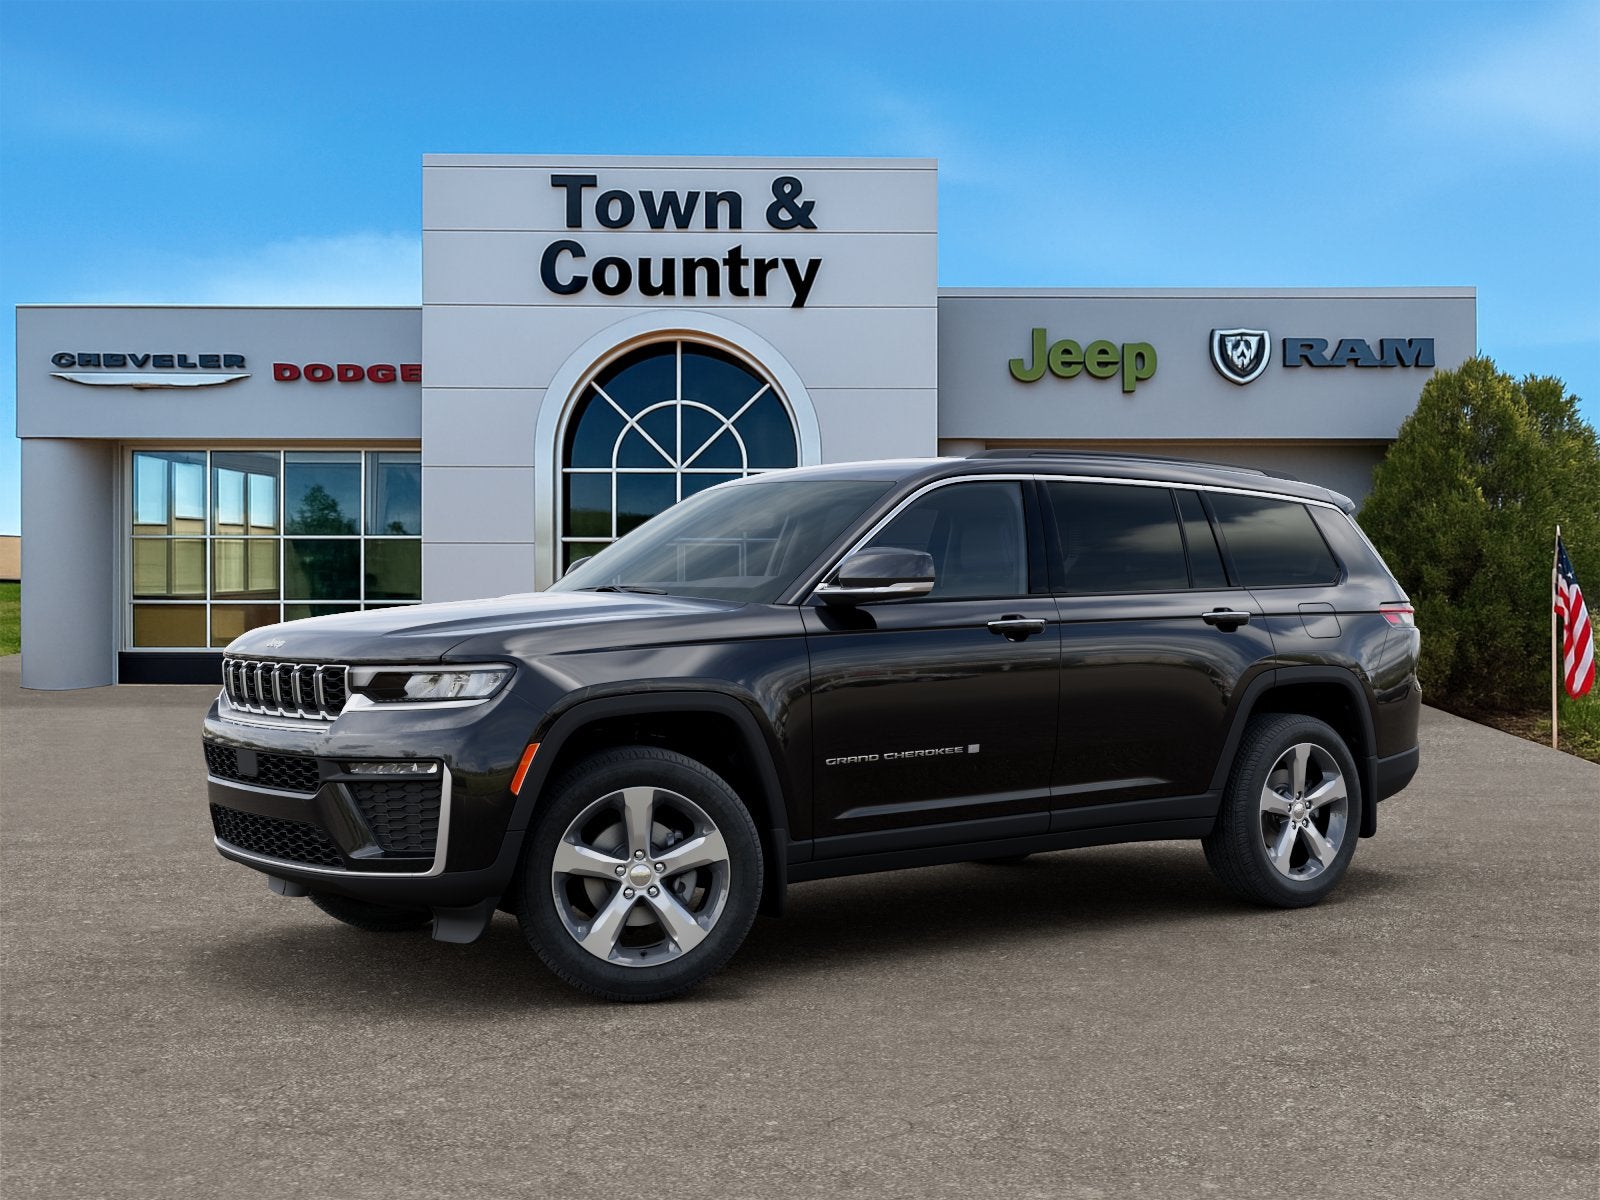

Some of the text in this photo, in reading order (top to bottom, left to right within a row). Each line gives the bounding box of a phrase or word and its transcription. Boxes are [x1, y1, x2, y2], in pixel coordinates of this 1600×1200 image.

[550, 174, 818, 230] Town &
[540, 239, 822, 308] Country
[273, 363, 422, 383] DODGE
[1008, 327, 1158, 393] Jeep
[1282, 338, 1435, 368] RAM
[826, 746, 964, 765] GRAND CHEROKEE
